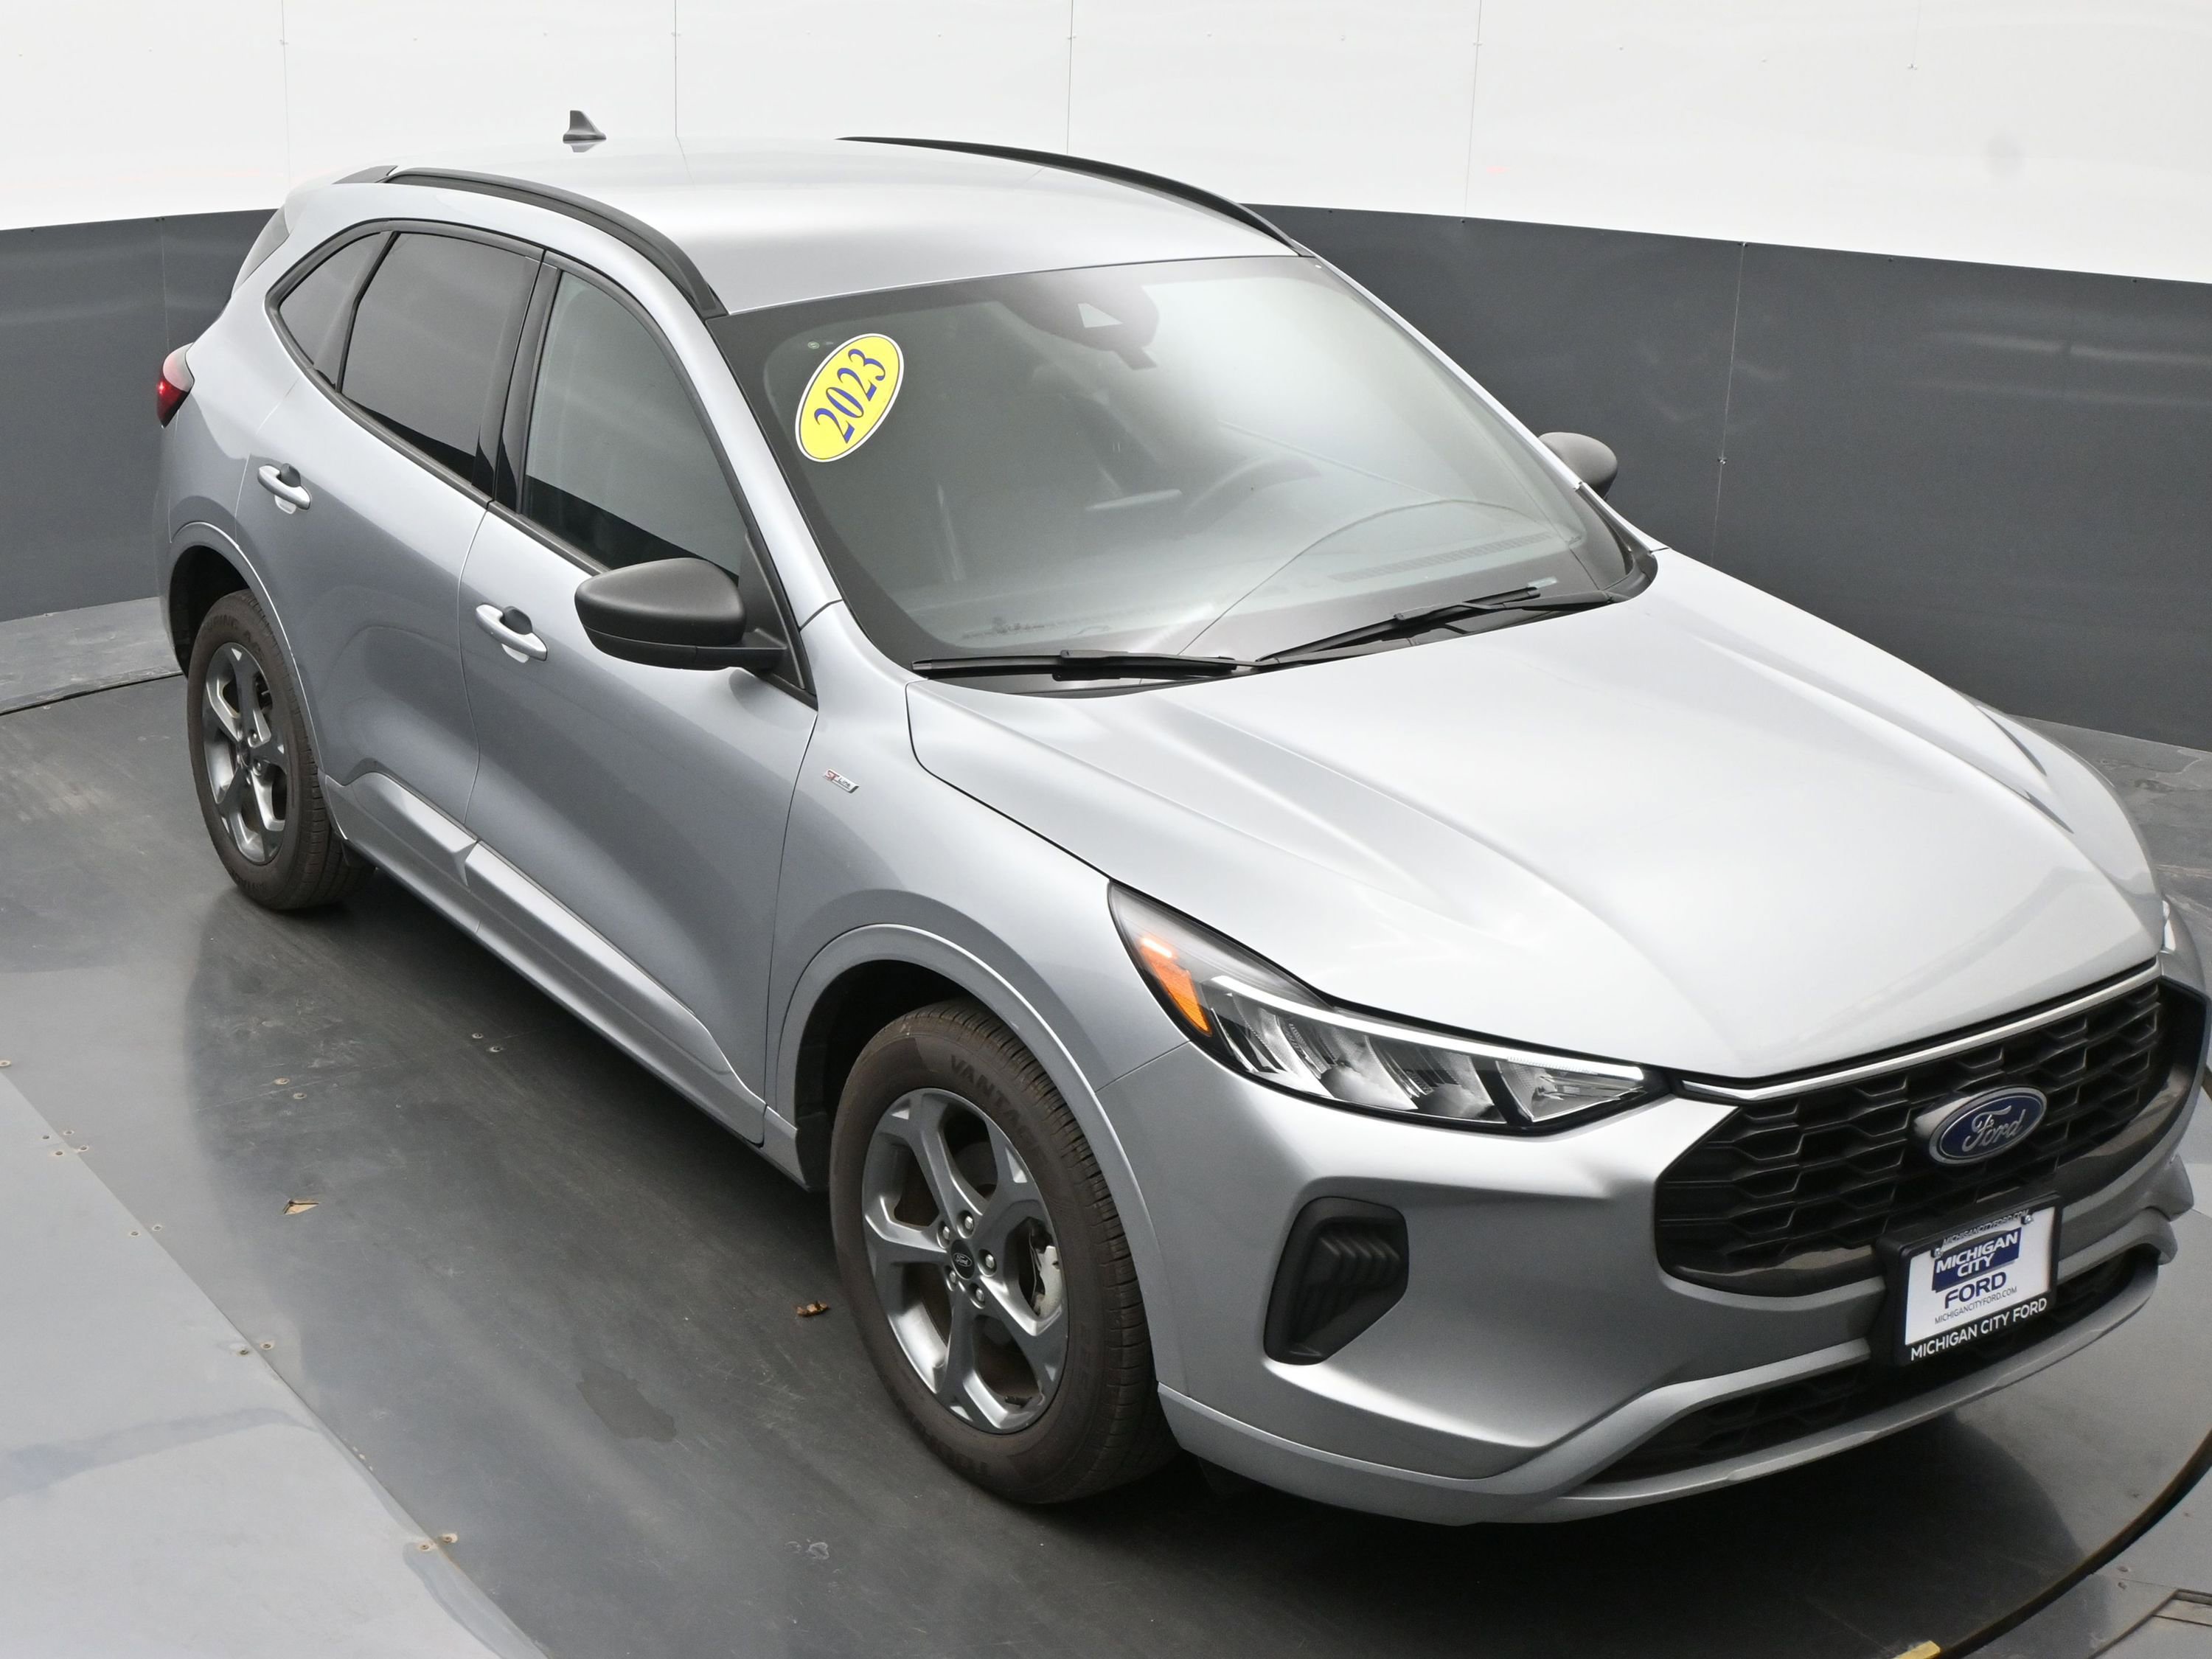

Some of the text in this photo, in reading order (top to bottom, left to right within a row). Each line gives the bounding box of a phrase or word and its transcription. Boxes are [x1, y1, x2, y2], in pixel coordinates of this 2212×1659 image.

[814, 349, 886, 443] 2023
[1961, 1105, 2026, 1152] Ford
[956, 1254, 969, 1265] Ford
[1935, 1231, 2019, 1274] MICHIGAN
[1957, 1252, 1995, 1277] CITY
[1934, 1286, 2017, 1324] MICHIGANCITYFORD.COM
[1944, 1271, 2007, 1310] FORD
[1910, 1297, 2048, 1361] MICHIGAN CITY FORD
